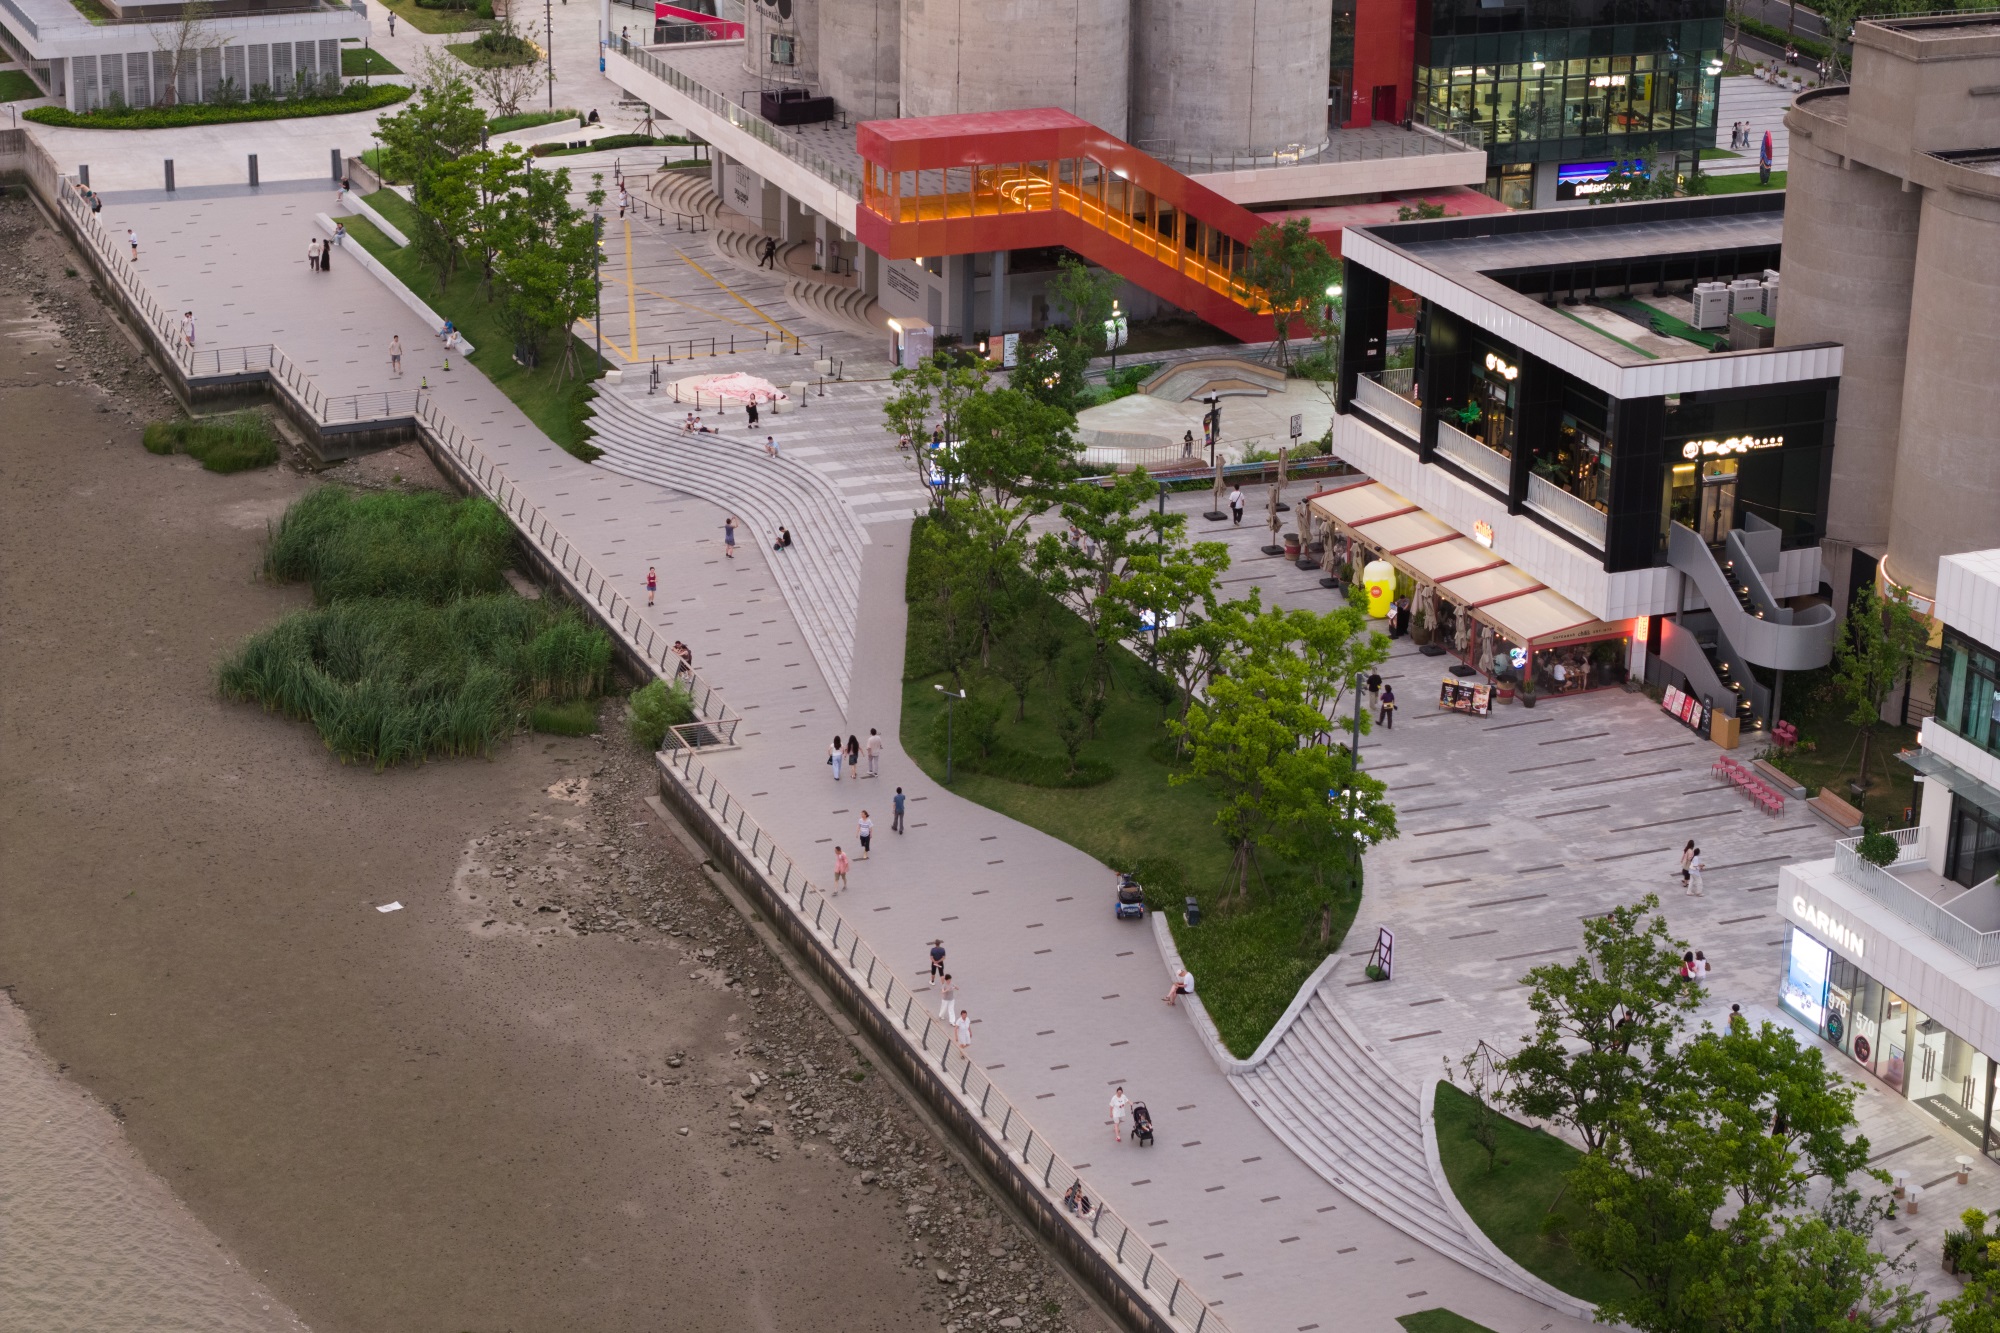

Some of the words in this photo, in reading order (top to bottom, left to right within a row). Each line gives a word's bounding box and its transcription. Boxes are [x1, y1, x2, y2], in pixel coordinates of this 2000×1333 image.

[1792, 895, 1865, 958] GARMIN
[1828, 992, 1847, 1018] 970
[1855, 1011, 1875, 1037] 570
[1929, 1098, 1961, 1120] GARMIN
